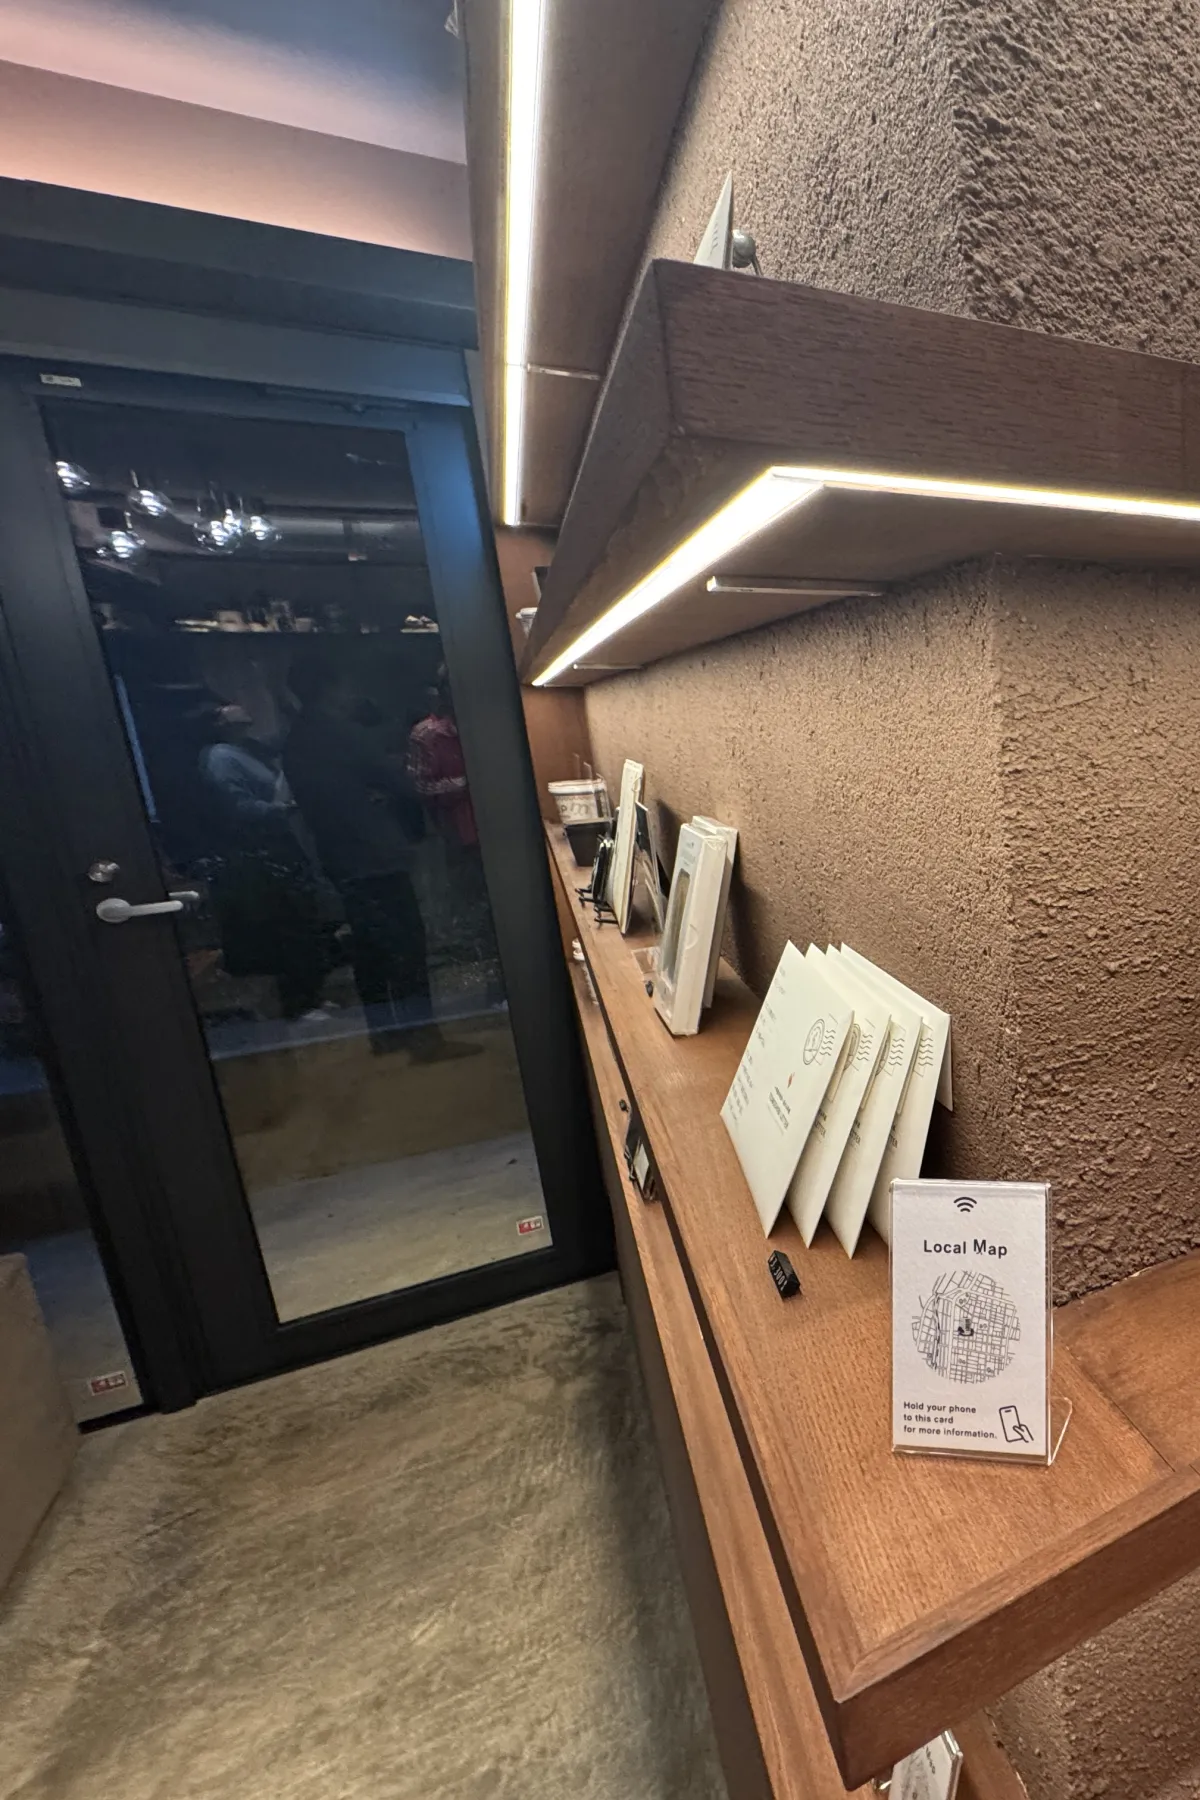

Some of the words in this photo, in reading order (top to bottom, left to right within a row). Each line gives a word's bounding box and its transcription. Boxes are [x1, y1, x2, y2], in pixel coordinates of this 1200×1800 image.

[923, 1239, 967, 1254] Local
[973, 1238, 1008, 1259] Map
[903, 1401, 924, 1411] Hold
[926, 1403, 946, 1412] your
[949, 1404, 977, 1414] phone
[903, 1413, 912, 1422] to
[915, 1414, 931, 1423] this
[934, 1416, 954, 1424] card
[903, 1425, 916, 1433] for
[918, 1426, 941, 1435] more
[943, 1427, 998, 1439] information.
